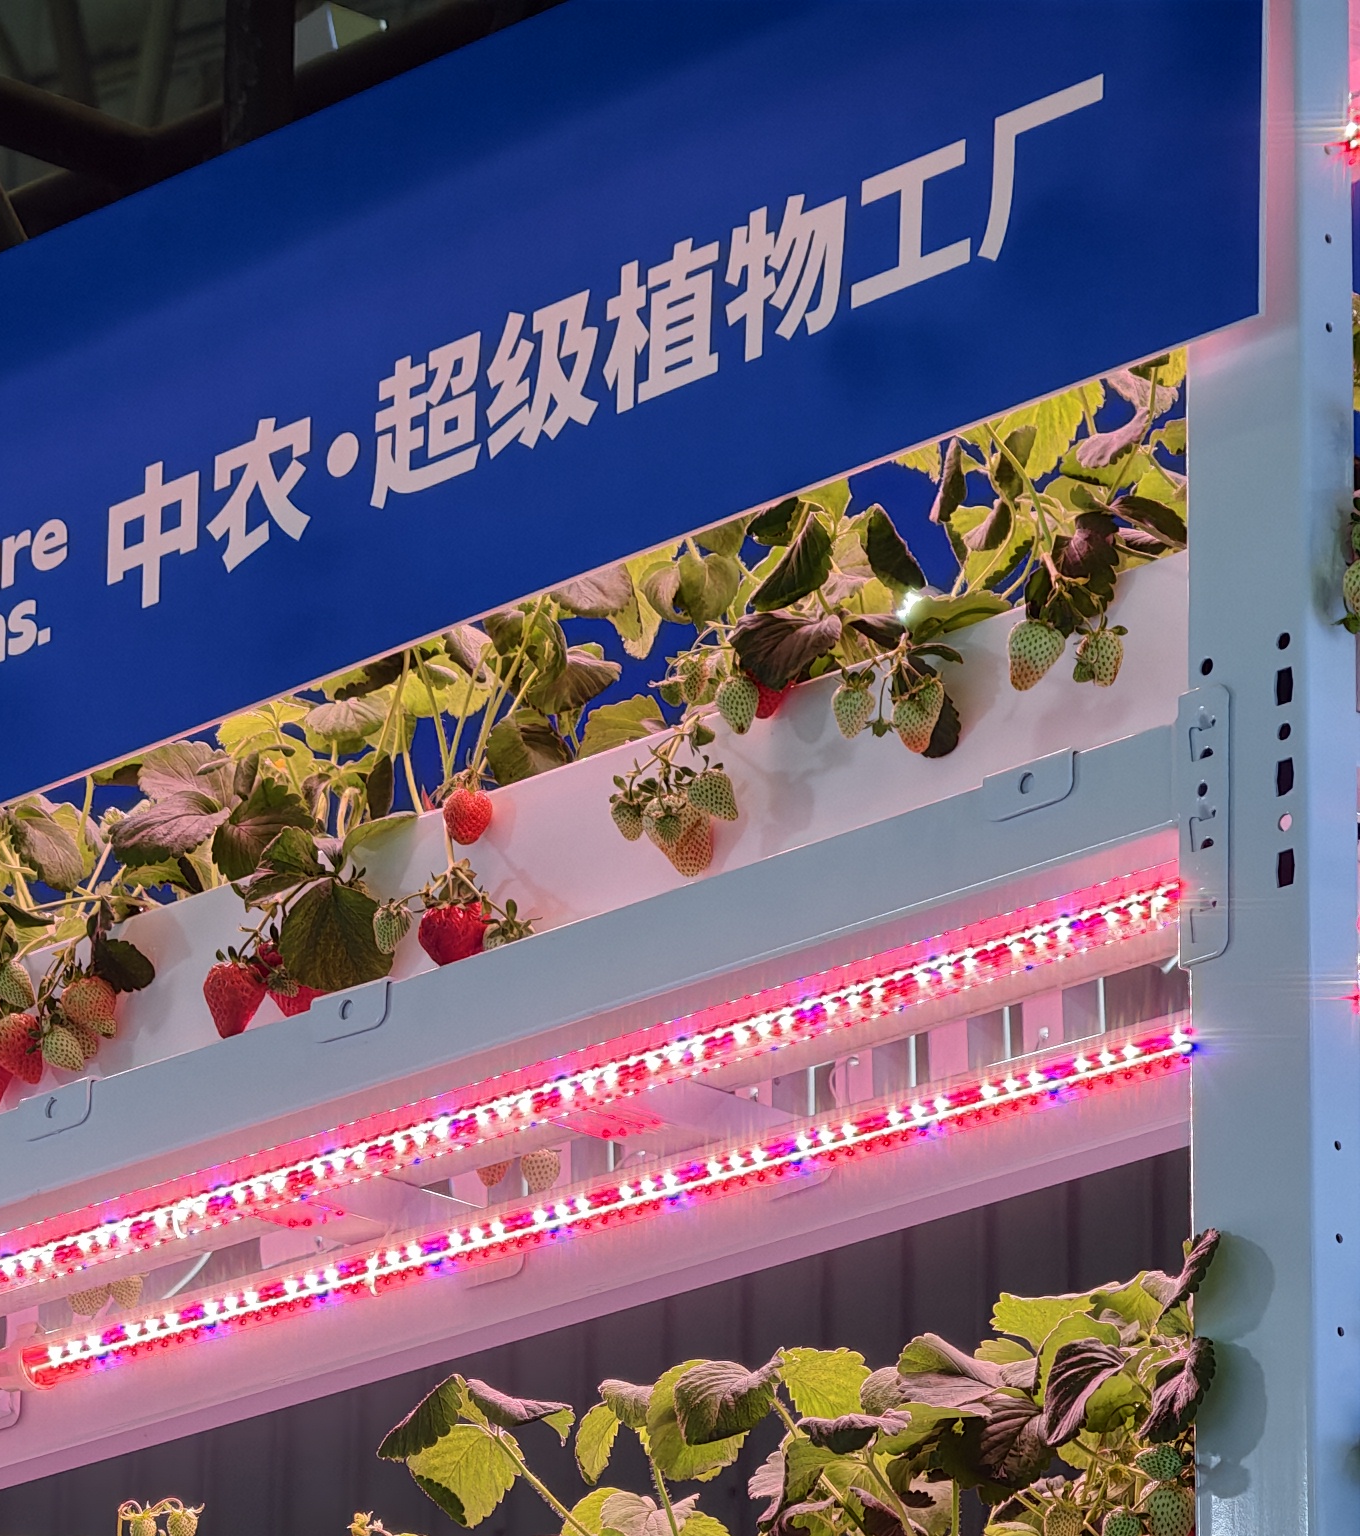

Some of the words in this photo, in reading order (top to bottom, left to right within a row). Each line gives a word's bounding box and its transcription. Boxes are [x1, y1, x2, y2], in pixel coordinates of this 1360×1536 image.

[106, 73, 1104, 609] 中农·超级植物工厂
